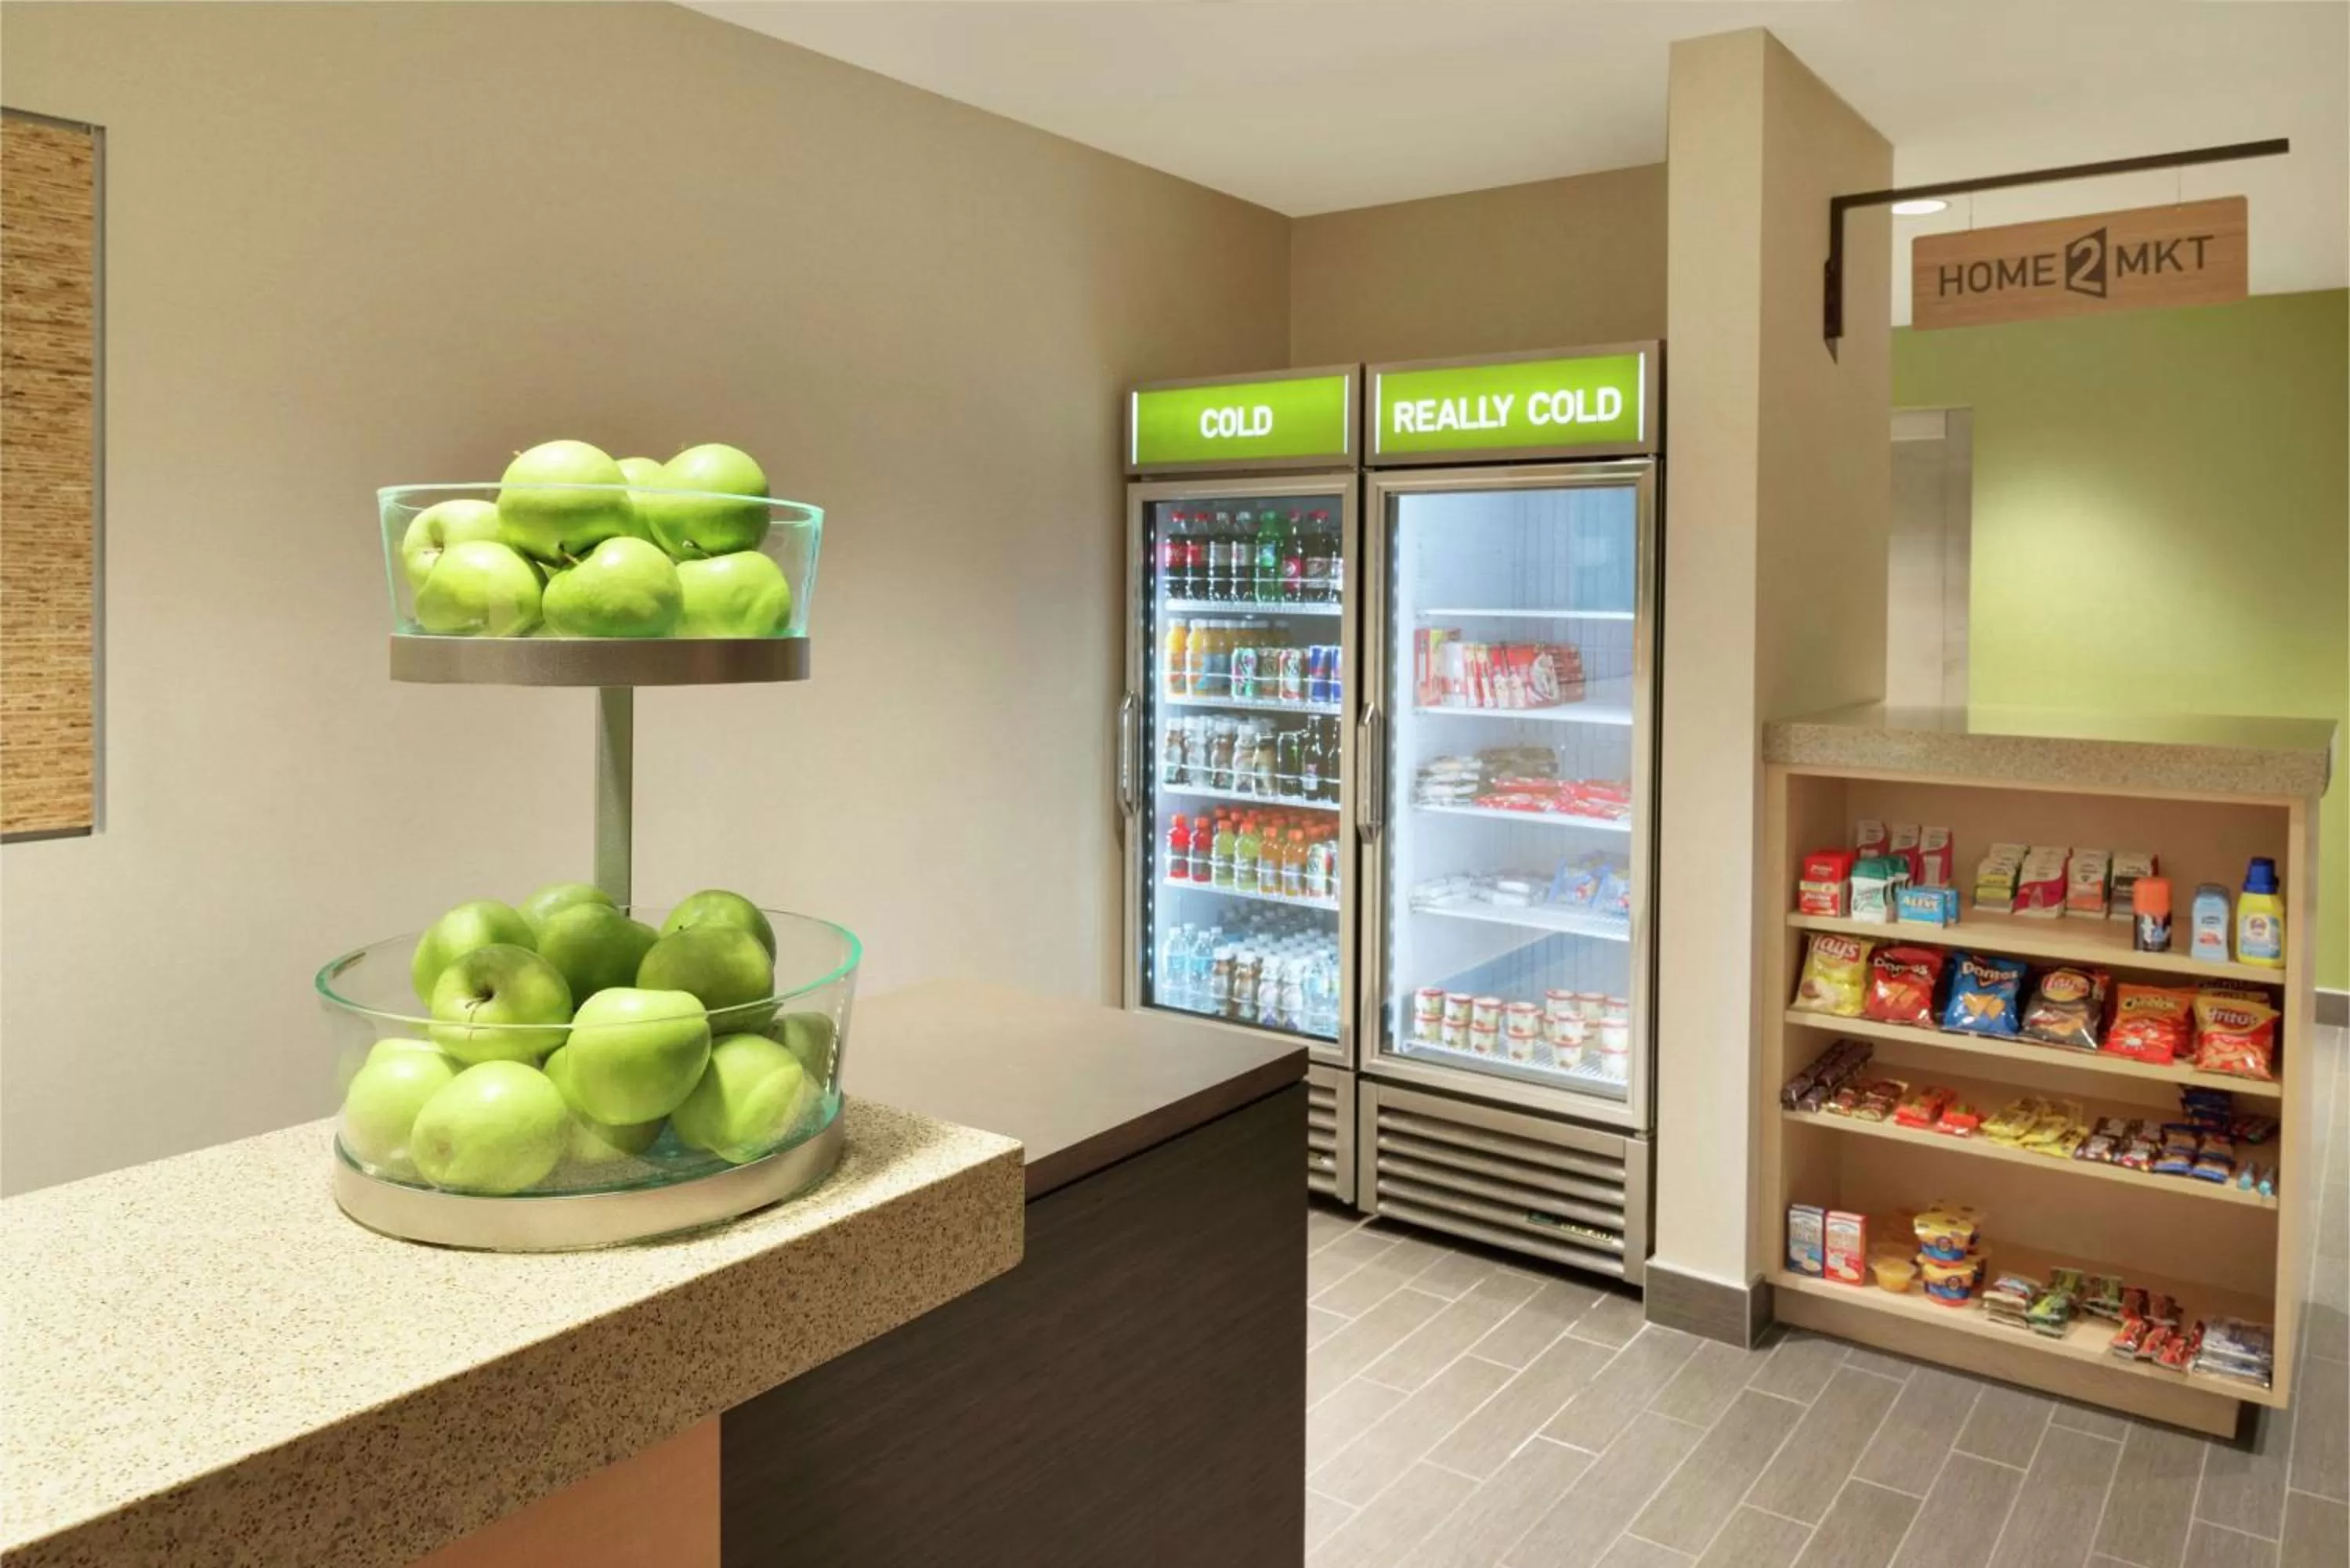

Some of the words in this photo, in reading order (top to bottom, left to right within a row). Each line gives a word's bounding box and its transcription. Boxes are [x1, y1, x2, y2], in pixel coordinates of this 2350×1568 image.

[1199, 405, 1274, 439] COLD
[1393, 394, 1516, 433] REALLY
[1527, 386, 1623, 425] COLD
